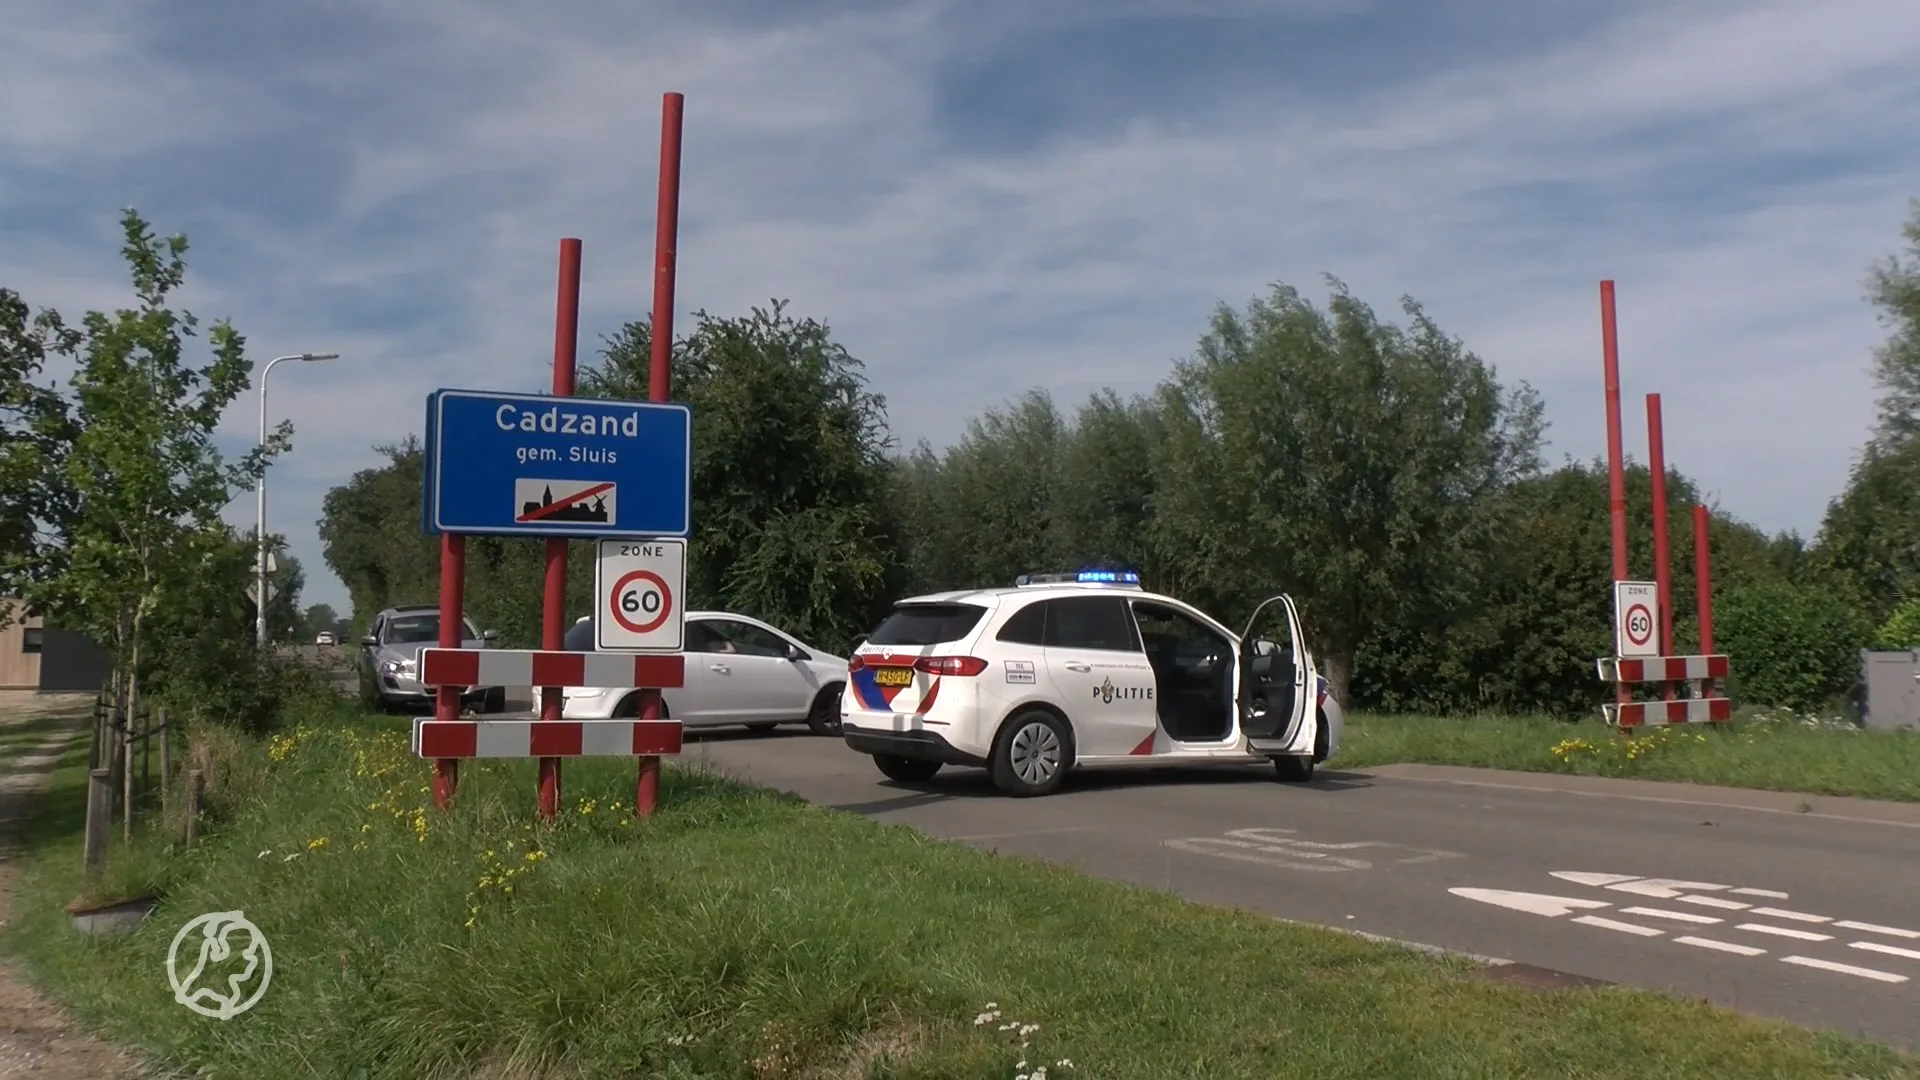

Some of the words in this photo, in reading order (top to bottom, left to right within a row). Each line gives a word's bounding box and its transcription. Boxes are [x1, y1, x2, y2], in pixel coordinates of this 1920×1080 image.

[496, 404, 638, 437] Cadzand
[516, 446, 563, 464] gem.
[569, 446, 617, 464] Sluis
[620, 545, 664, 557] ZONE
[1628, 587, 1648, 595] ZONE
[622, 590, 660, 613] 60
[1631, 616, 1648, 632] 60
[1093, 675, 1153, 704] POLITIE
